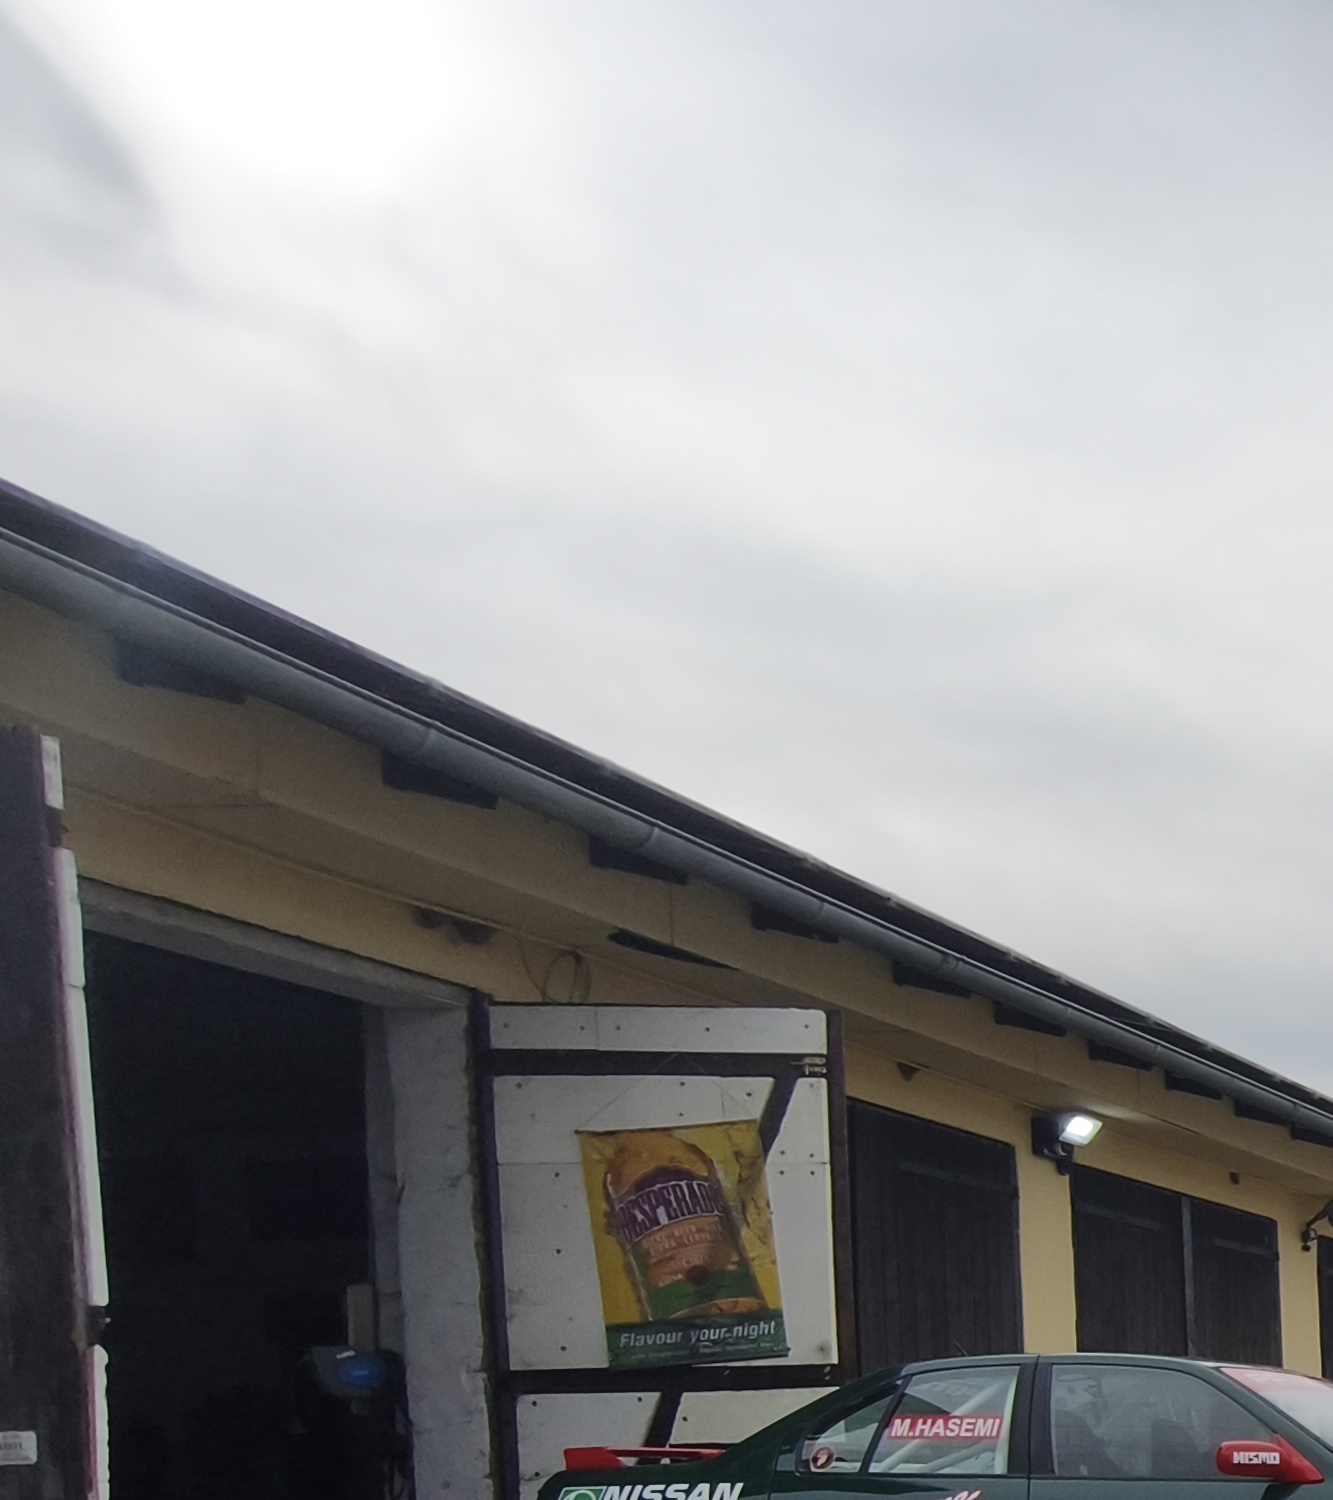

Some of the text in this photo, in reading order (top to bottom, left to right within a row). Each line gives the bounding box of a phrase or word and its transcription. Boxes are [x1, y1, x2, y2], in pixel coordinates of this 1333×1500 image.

[619, 1320, 776, 1348] Flavour your night
[890, 1418, 1001, 1437] M.HASEMI
[1232, 1451, 1281, 1465] NISMO
